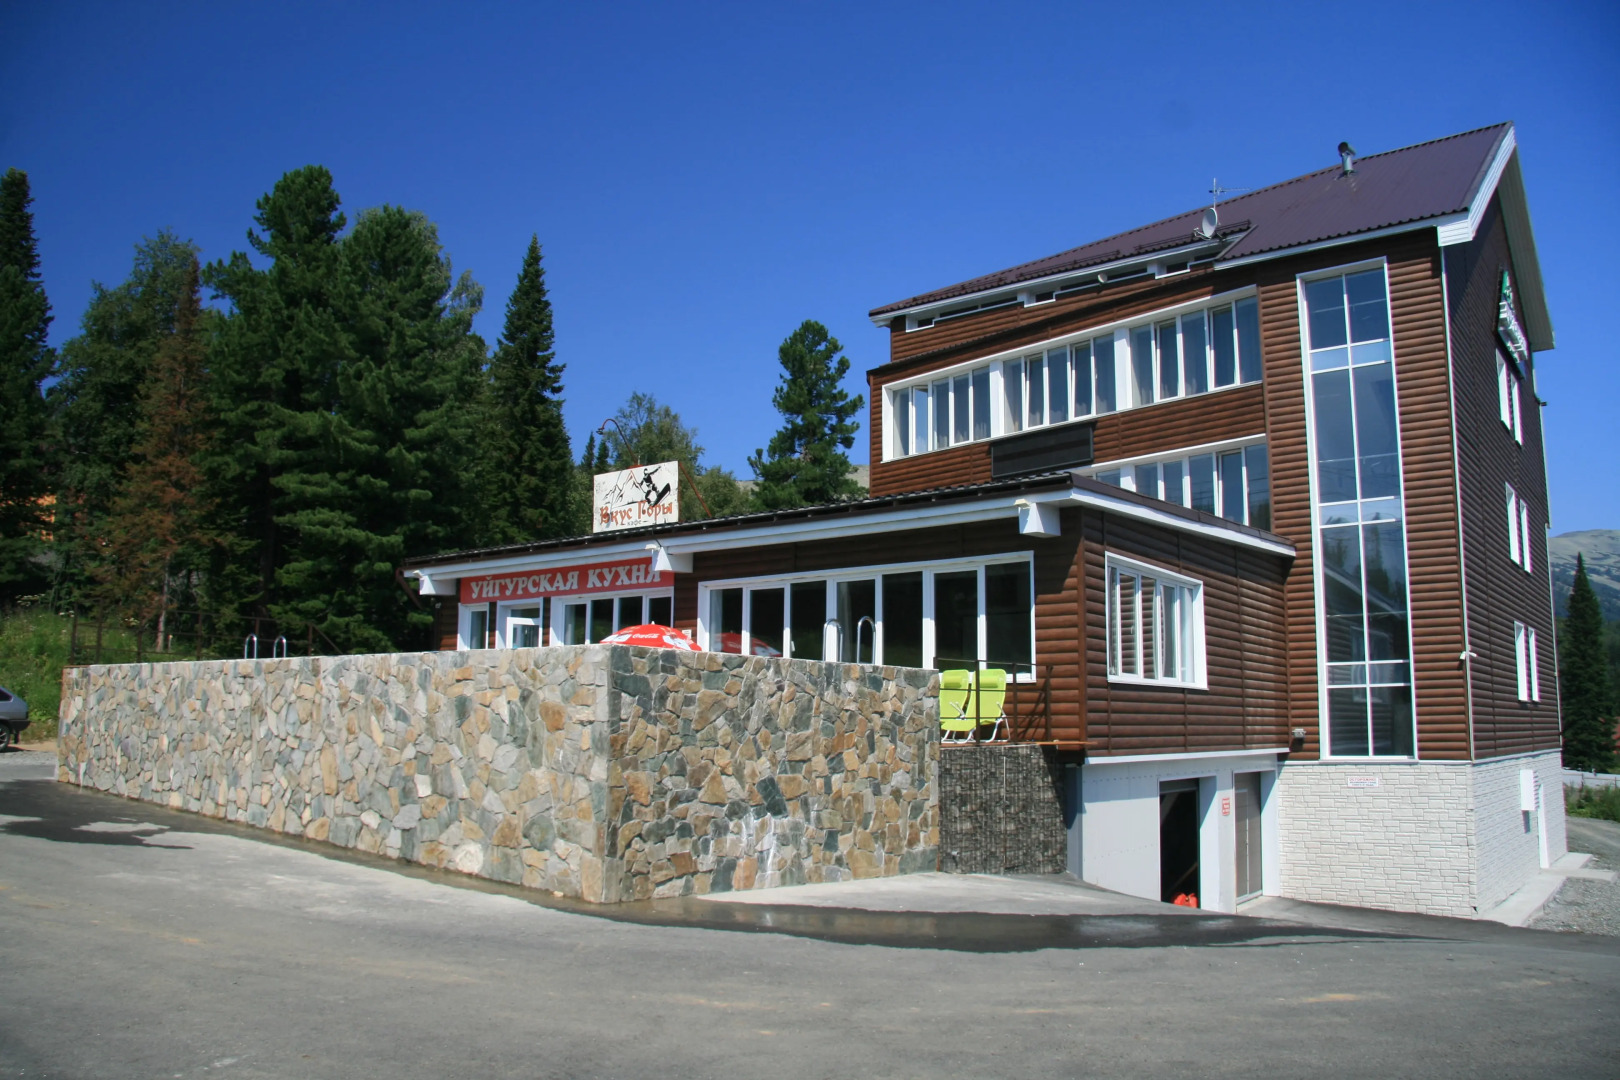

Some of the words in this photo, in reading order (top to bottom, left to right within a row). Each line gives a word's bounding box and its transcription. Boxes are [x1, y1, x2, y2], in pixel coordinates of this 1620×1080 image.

[600, 506, 632, 526] Вкус
[637, 500, 673, 524] Горы
[470, 570, 579, 600] УЙГУРСКАЯ
